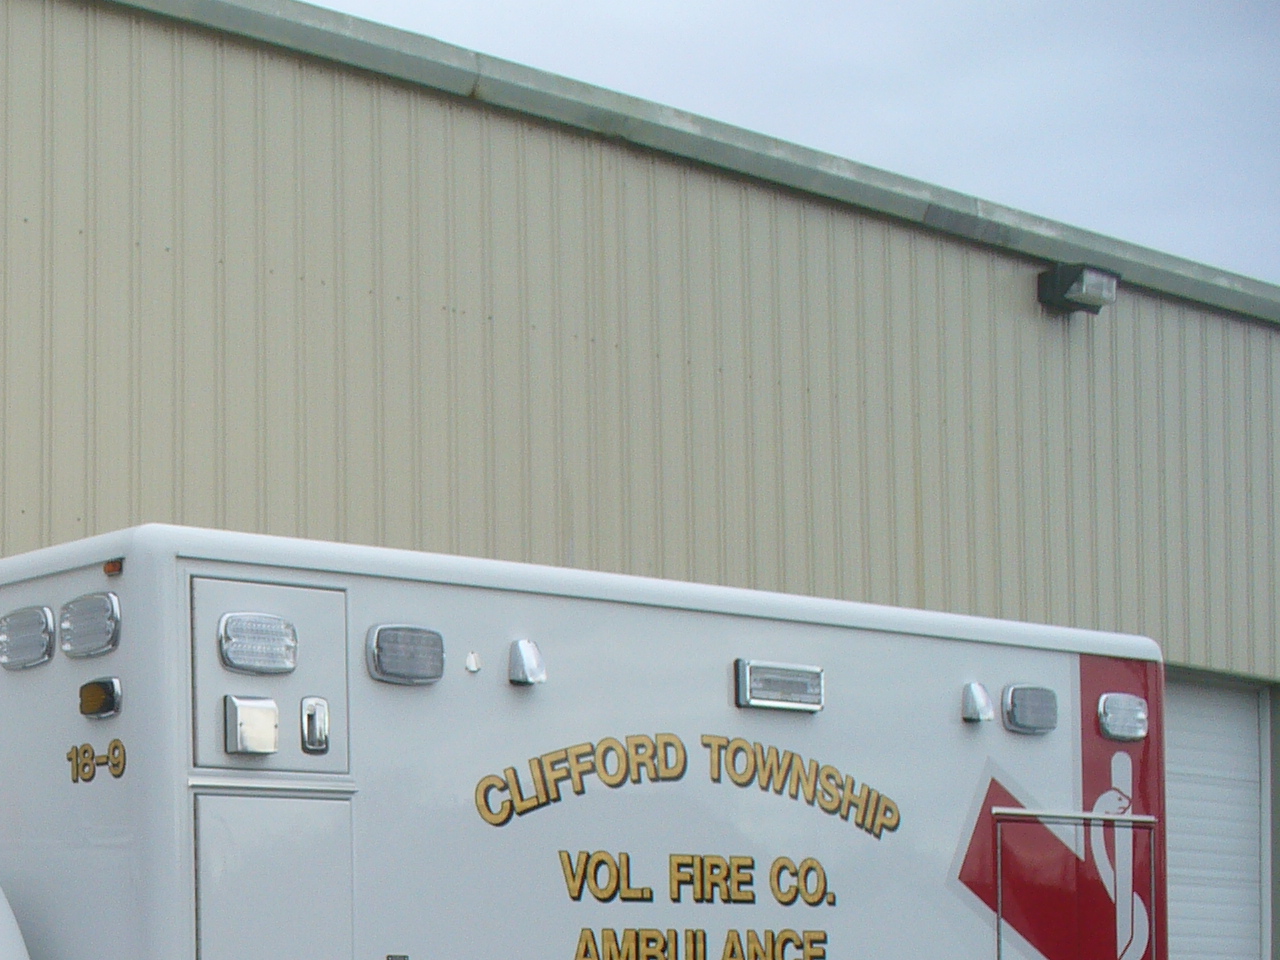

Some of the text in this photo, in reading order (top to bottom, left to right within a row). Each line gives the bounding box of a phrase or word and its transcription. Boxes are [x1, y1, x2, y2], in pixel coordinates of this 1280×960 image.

[66, 738, 126, 783] 18-9
[474, 732, 901, 839] CLIFFORD TOWNSHIP
[558, 850, 836, 906] VOL. FIRE CO.
